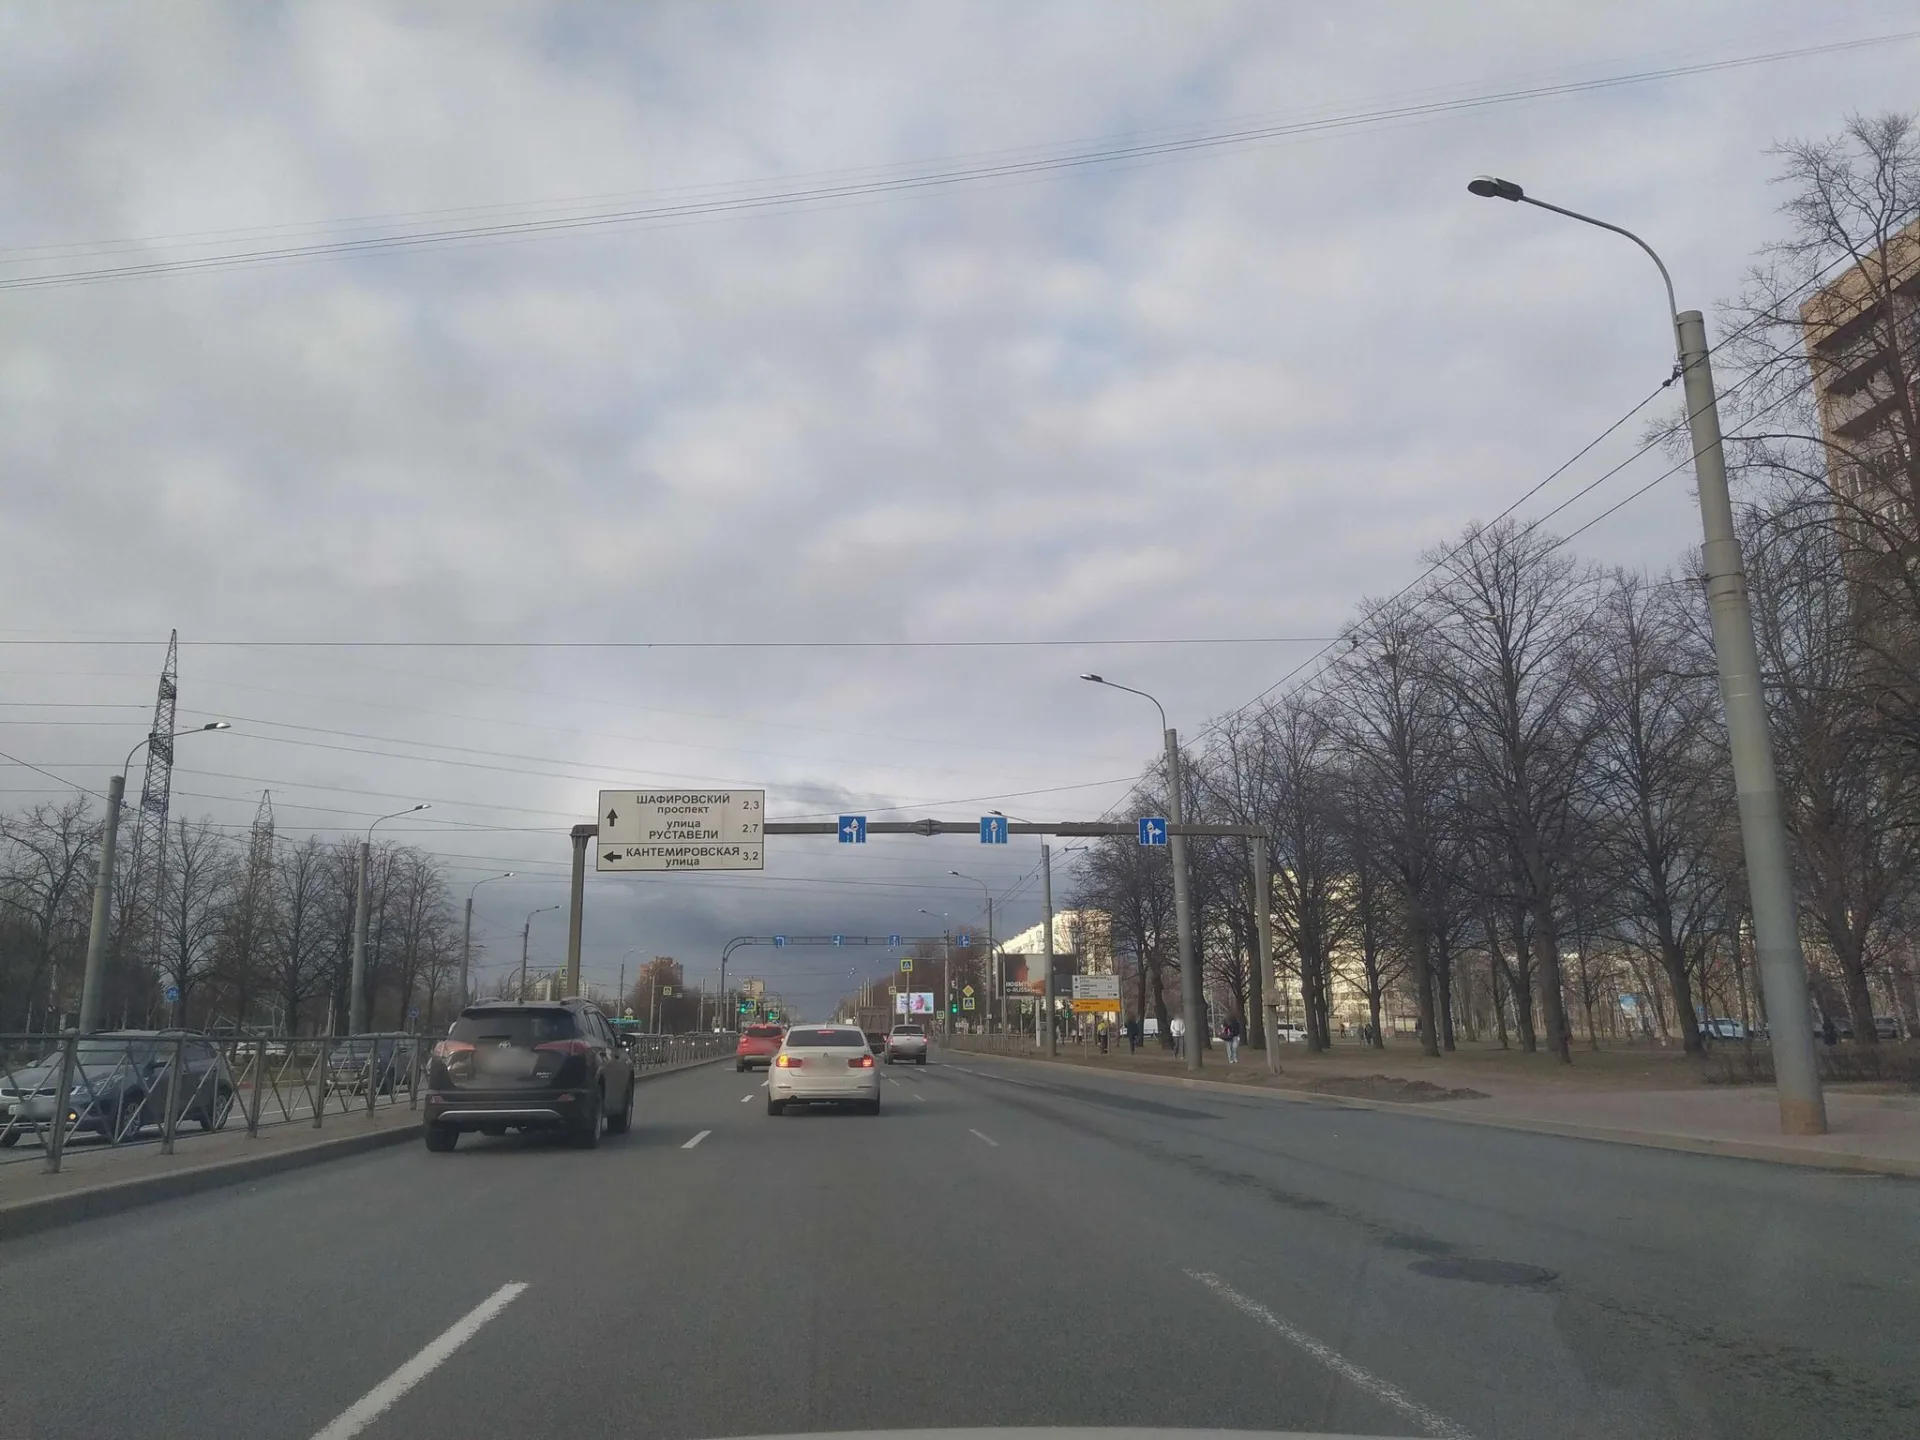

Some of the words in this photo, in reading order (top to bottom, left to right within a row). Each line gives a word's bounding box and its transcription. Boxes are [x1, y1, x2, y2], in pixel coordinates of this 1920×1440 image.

[636, 793, 730, 804] ШАФИРОВСКИЙ
[657, 806, 709, 815] проспект
[743, 801, 760, 811] 2,3
[666, 820, 701, 829] улица
[742, 824, 759, 834] 2,7
[649, 830, 719, 840] РУСТАВЕЛИ
[626, 847, 740, 857] КАНТЕМИРОВСКАЯ
[743, 851, 759, 862] 3,2
[665, 858, 700, 868] улица
